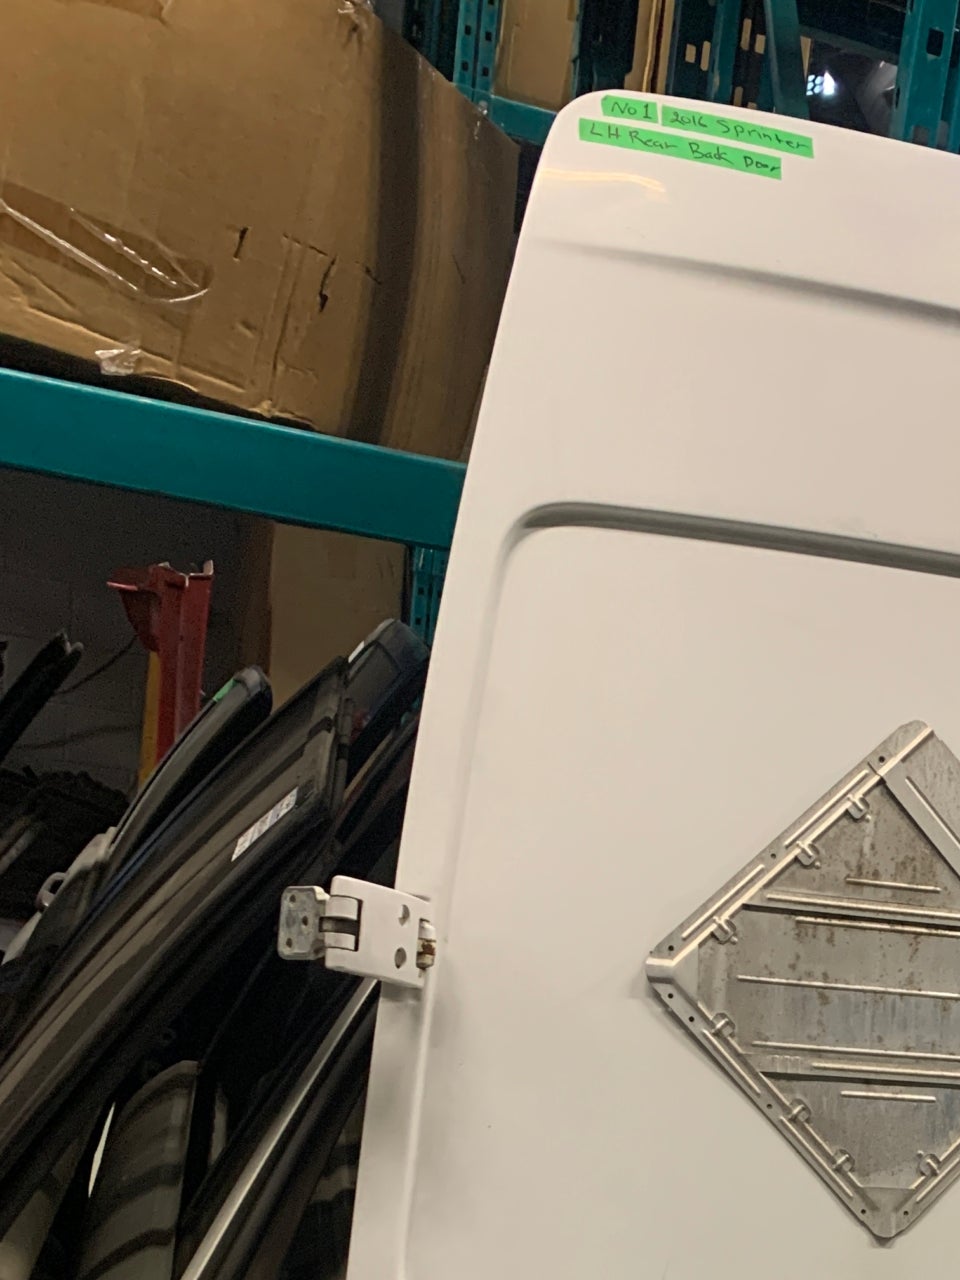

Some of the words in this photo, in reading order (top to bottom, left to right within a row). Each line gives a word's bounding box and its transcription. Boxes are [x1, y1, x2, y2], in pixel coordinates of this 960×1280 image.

[670, 111, 708, 128] 2016
[716, 119, 809, 149] Sprinter
[629, 130, 678, 150] Rear
[688, 141, 734, 165] Back
[743, 155, 781, 172] Door
